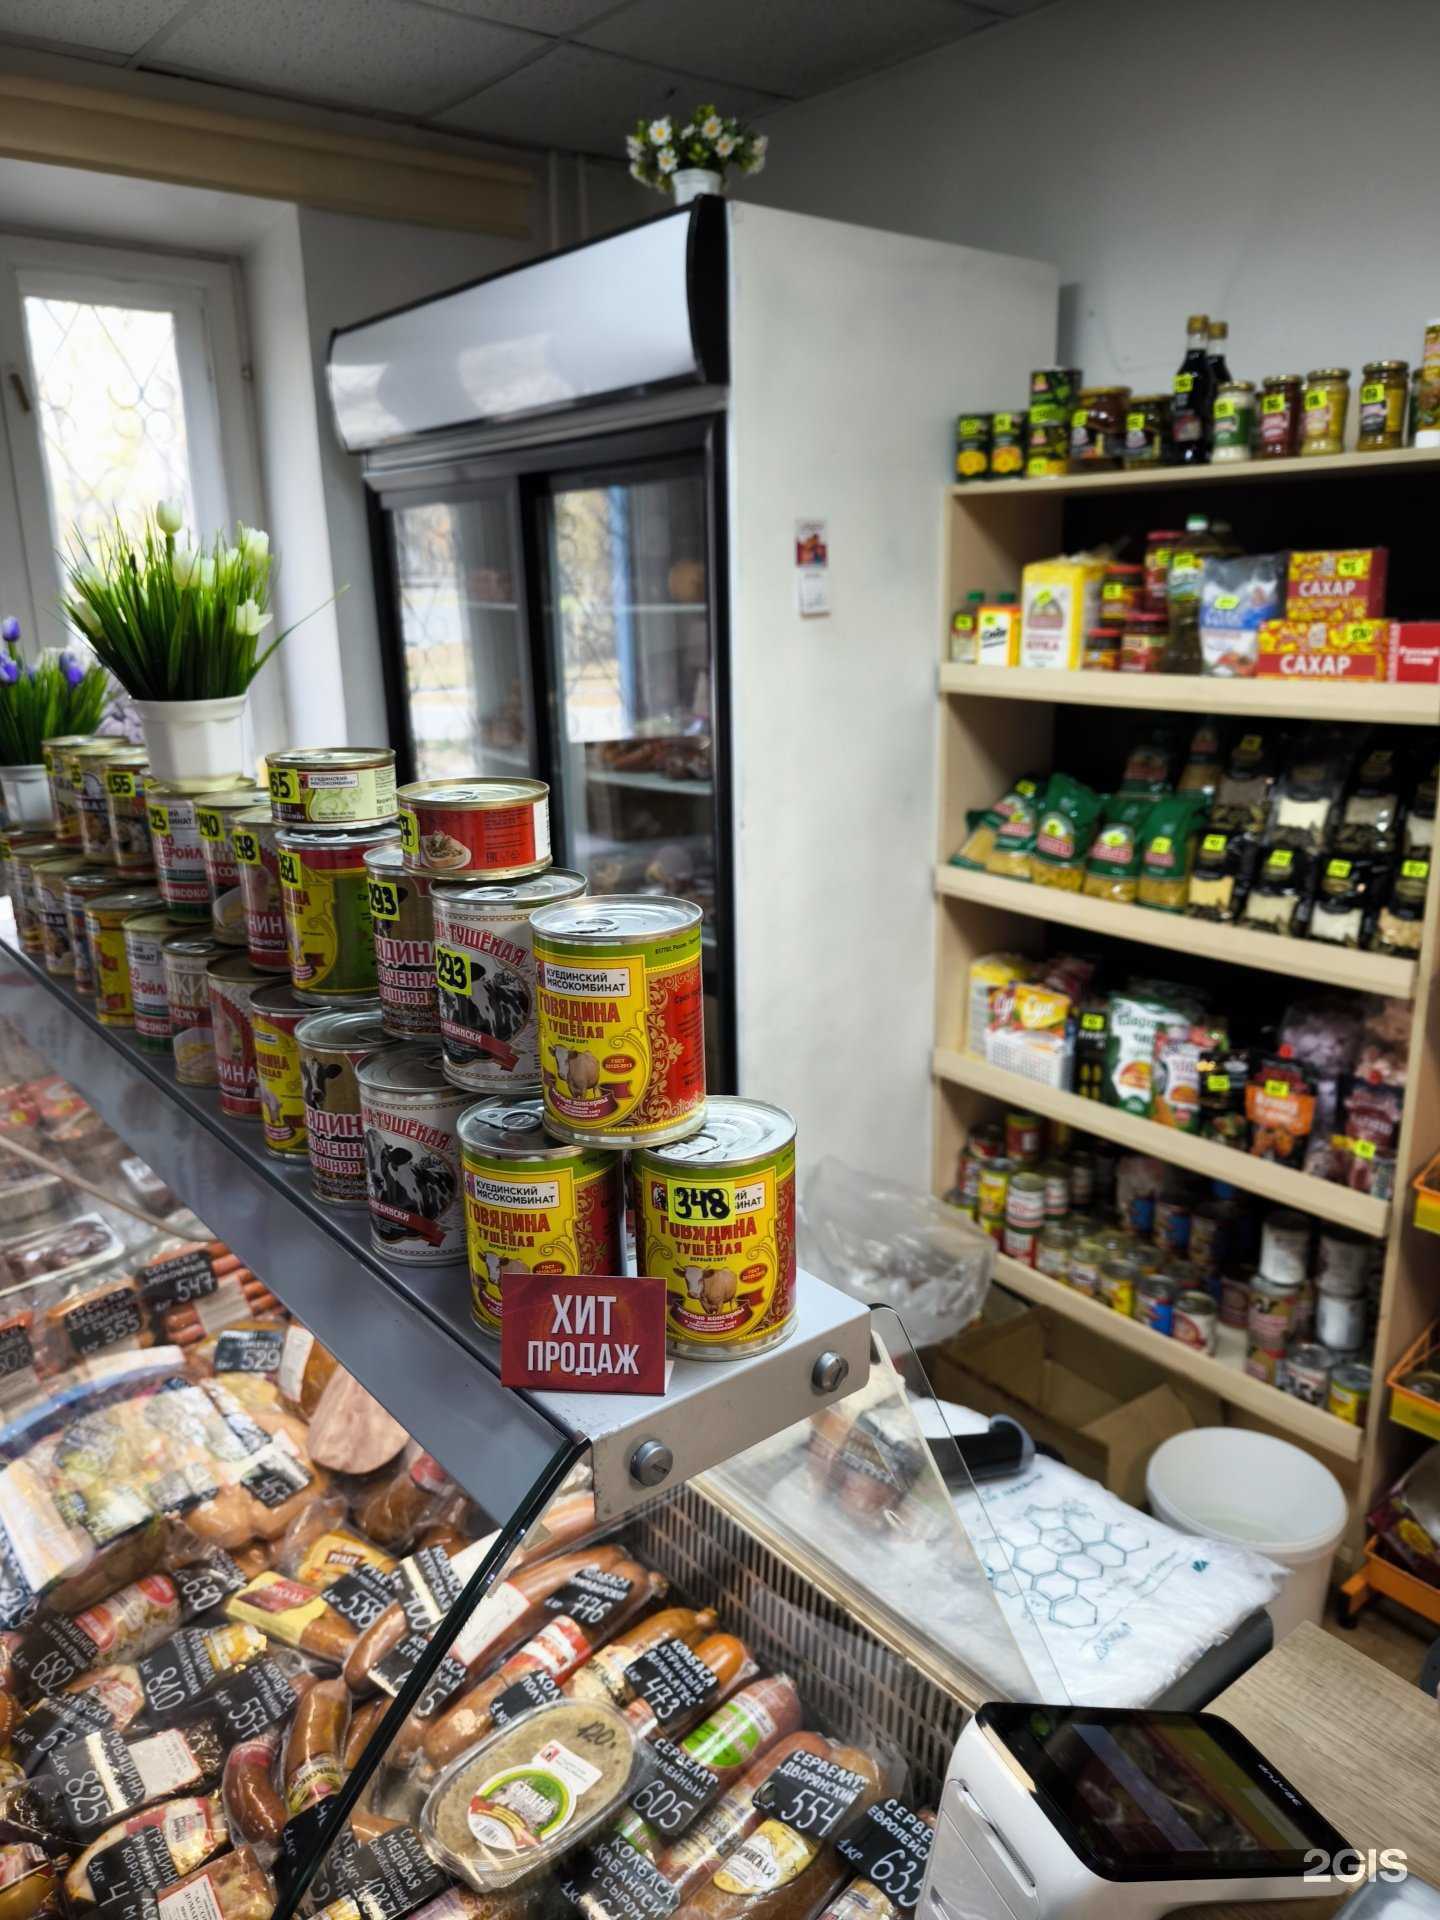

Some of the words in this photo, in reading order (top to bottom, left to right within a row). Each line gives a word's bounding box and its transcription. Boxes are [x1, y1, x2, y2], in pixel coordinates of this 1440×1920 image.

[1299, 580, 1356, 597] САХАР
[1280, 656, 1351, 675] САХАР
[546, 967, 608, 983] КУЕДИНСКИЙ
[546, 977, 626, 992] МЯСОКОМБИНАТ
[539, 991, 621, 1025] ГОВЯДИНА
[475, 1179, 538, 1196] КУЕДИНСКИЙ
[476, 1188, 556, 1205] МЯСОКОМБИНАТ
[673, 1186, 732, 1220] 348
[469, 1204, 551, 1236] ГОВЯДИНА
[658, 1216, 758, 1244] ГОВЯДИНА
[176, 1271, 215, 1301] 547
[103, 1315, 140, 1345] 355
[551, 1294, 617, 1336] ХИТ
[242, 1347, 281, 1372] 529
[526, 1339, 641, 1377] ПРОДАЖ
[184, 1575, 222, 1612] 650
[338, 1591, 386, 1629] 558
[30, 1650, 75, 1694] 682
[671, 1639, 717, 1687] КОЛБАСА
[146, 1666, 186, 1711] 810
[646, 1679, 682, 1720] 473
[228, 1697, 269, 1740] 557
[107, 1730, 146, 1799] ГОВЯДИНА
[648, 1753, 707, 1801] ИЛЕЙНЫЙ
[653, 1737, 720, 1785] СЕРВЕЛАТ
[792, 1749, 868, 1789] СЕРВЕЛАТ
[65, 1770, 111, 1825] 825
[631, 1779, 694, 1830] 605
[780, 1789, 844, 1838] 554
[384, 1833, 423, 1891] МЕДОВАЯ
[610, 1835, 677, 1905] КОЛБАСА
